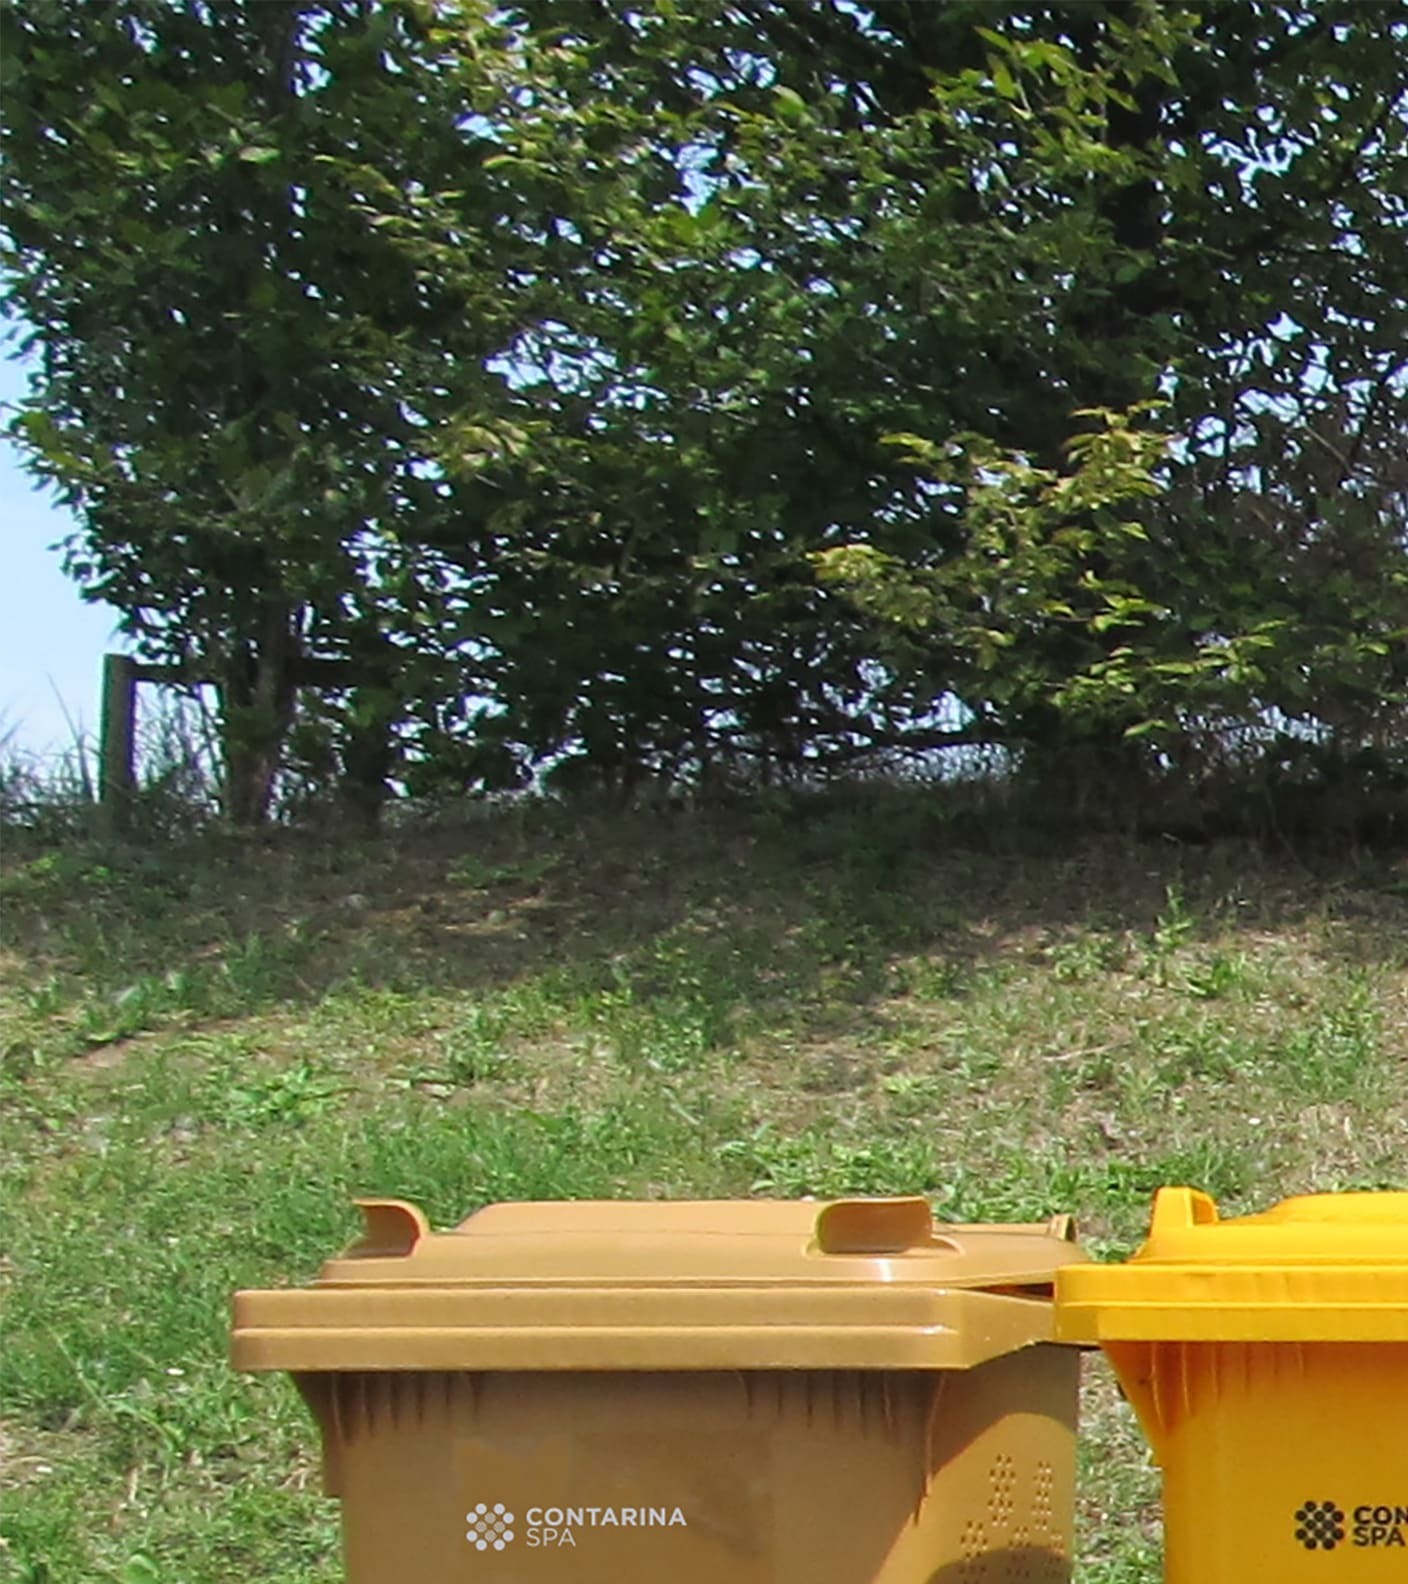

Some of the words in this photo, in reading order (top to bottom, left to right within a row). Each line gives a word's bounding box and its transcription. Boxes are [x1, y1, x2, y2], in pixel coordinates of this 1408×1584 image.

[526, 1507, 687, 1526] CONTARINA
[526, 1528, 576, 1547] SPA
[1353, 1527, 1406, 1547] SPA
